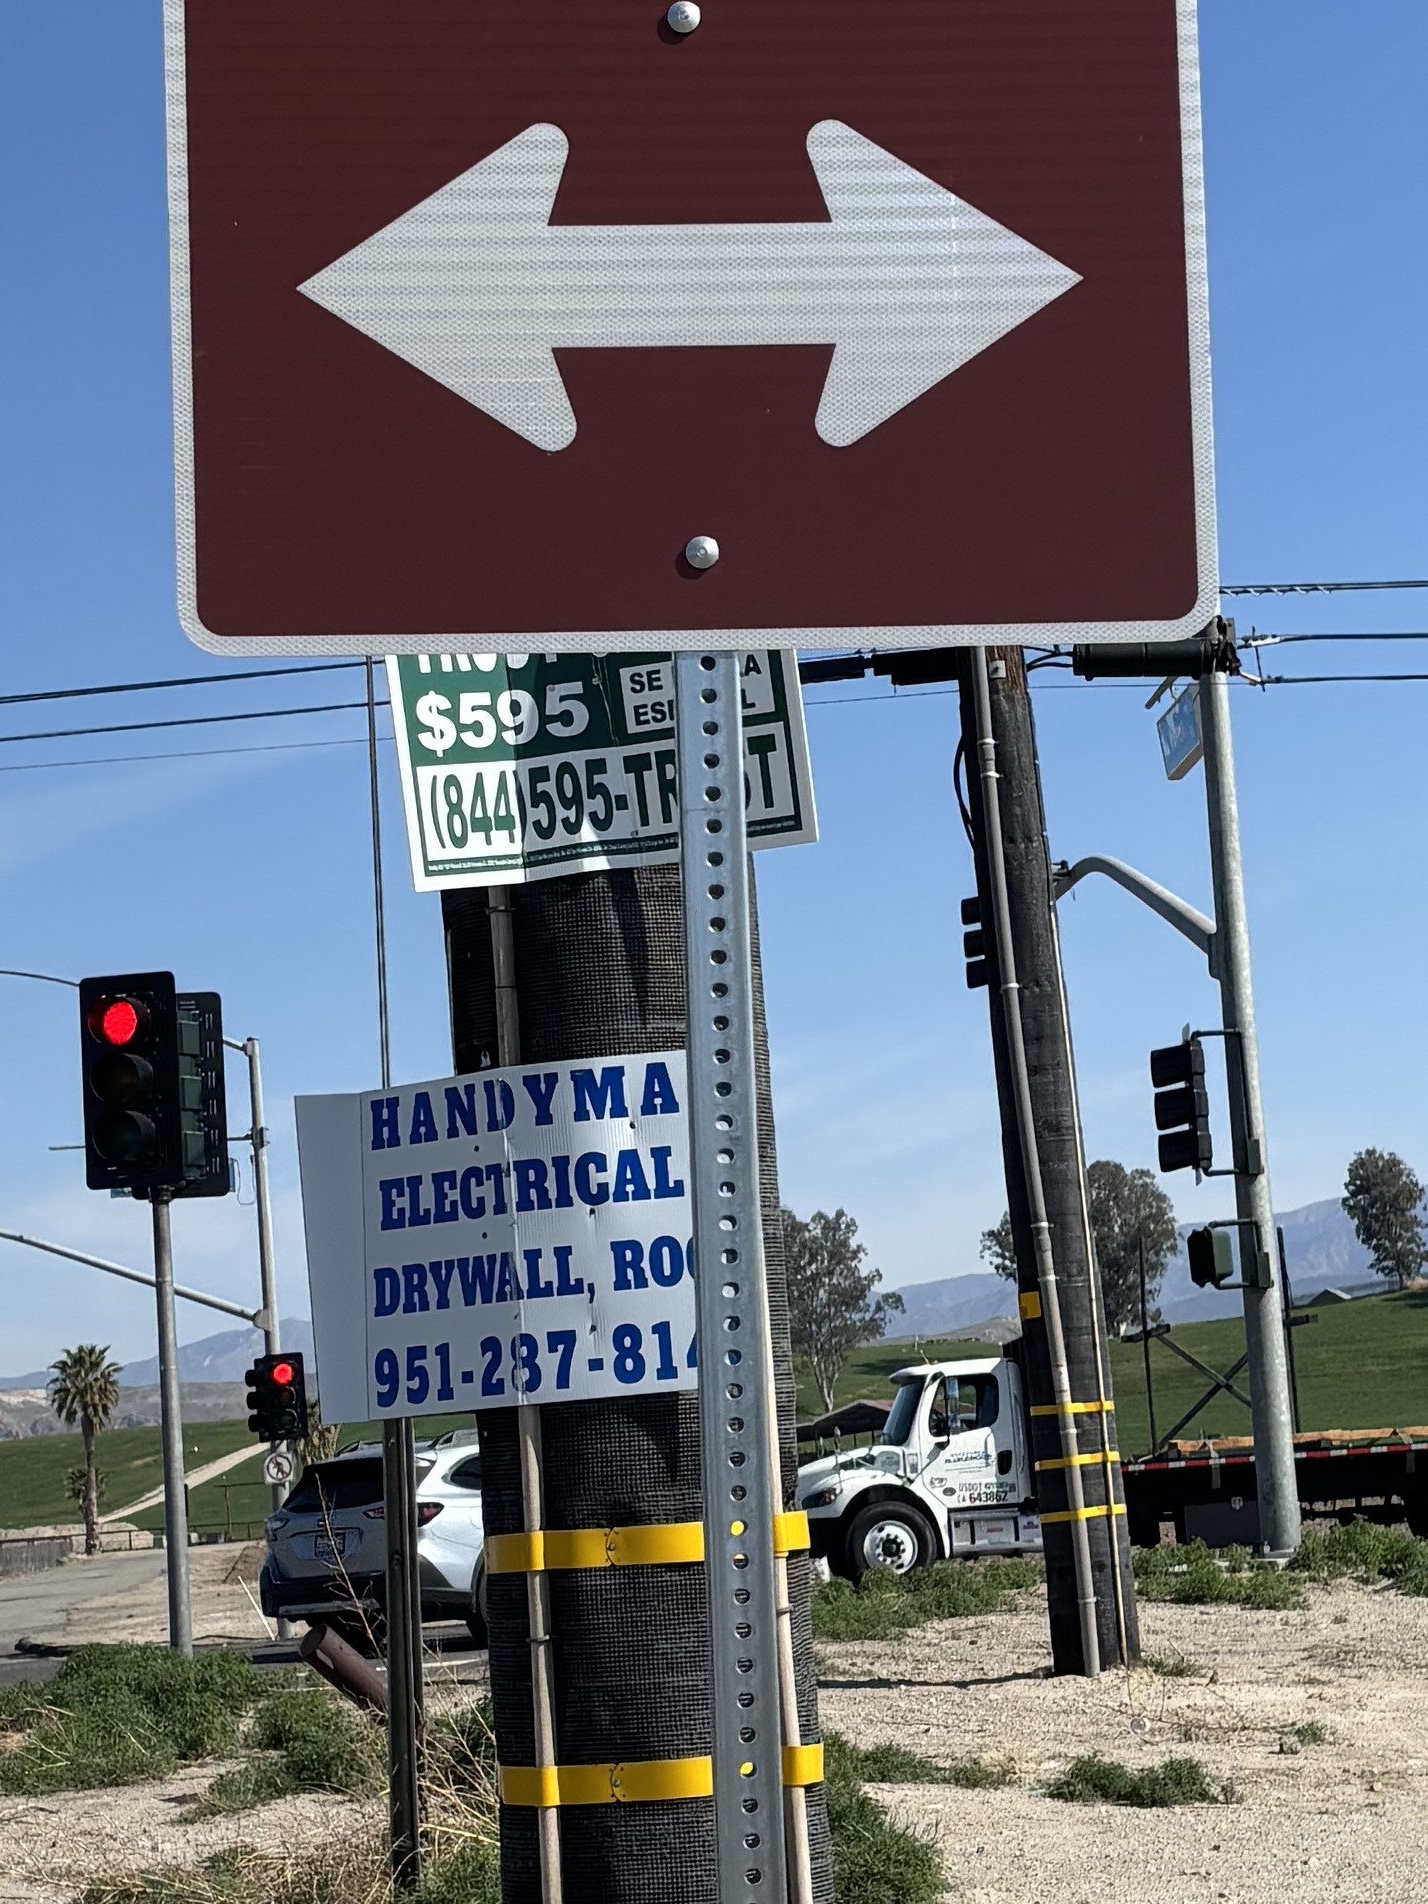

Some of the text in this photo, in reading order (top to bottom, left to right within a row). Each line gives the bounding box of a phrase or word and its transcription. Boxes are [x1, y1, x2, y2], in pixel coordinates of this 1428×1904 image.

[416, 680, 590, 758] $595
[630, 668, 662, 695] SE
[430, 733, 778, 850] (844)595-TRT
[370, 1061, 680, 1152] HANDYMA
[379, 1145, 685, 1232] ELECTRICAL
[373, 1245, 595, 1318] DRYWALL,
[374, 1319, 698, 1409] 951-287-81
